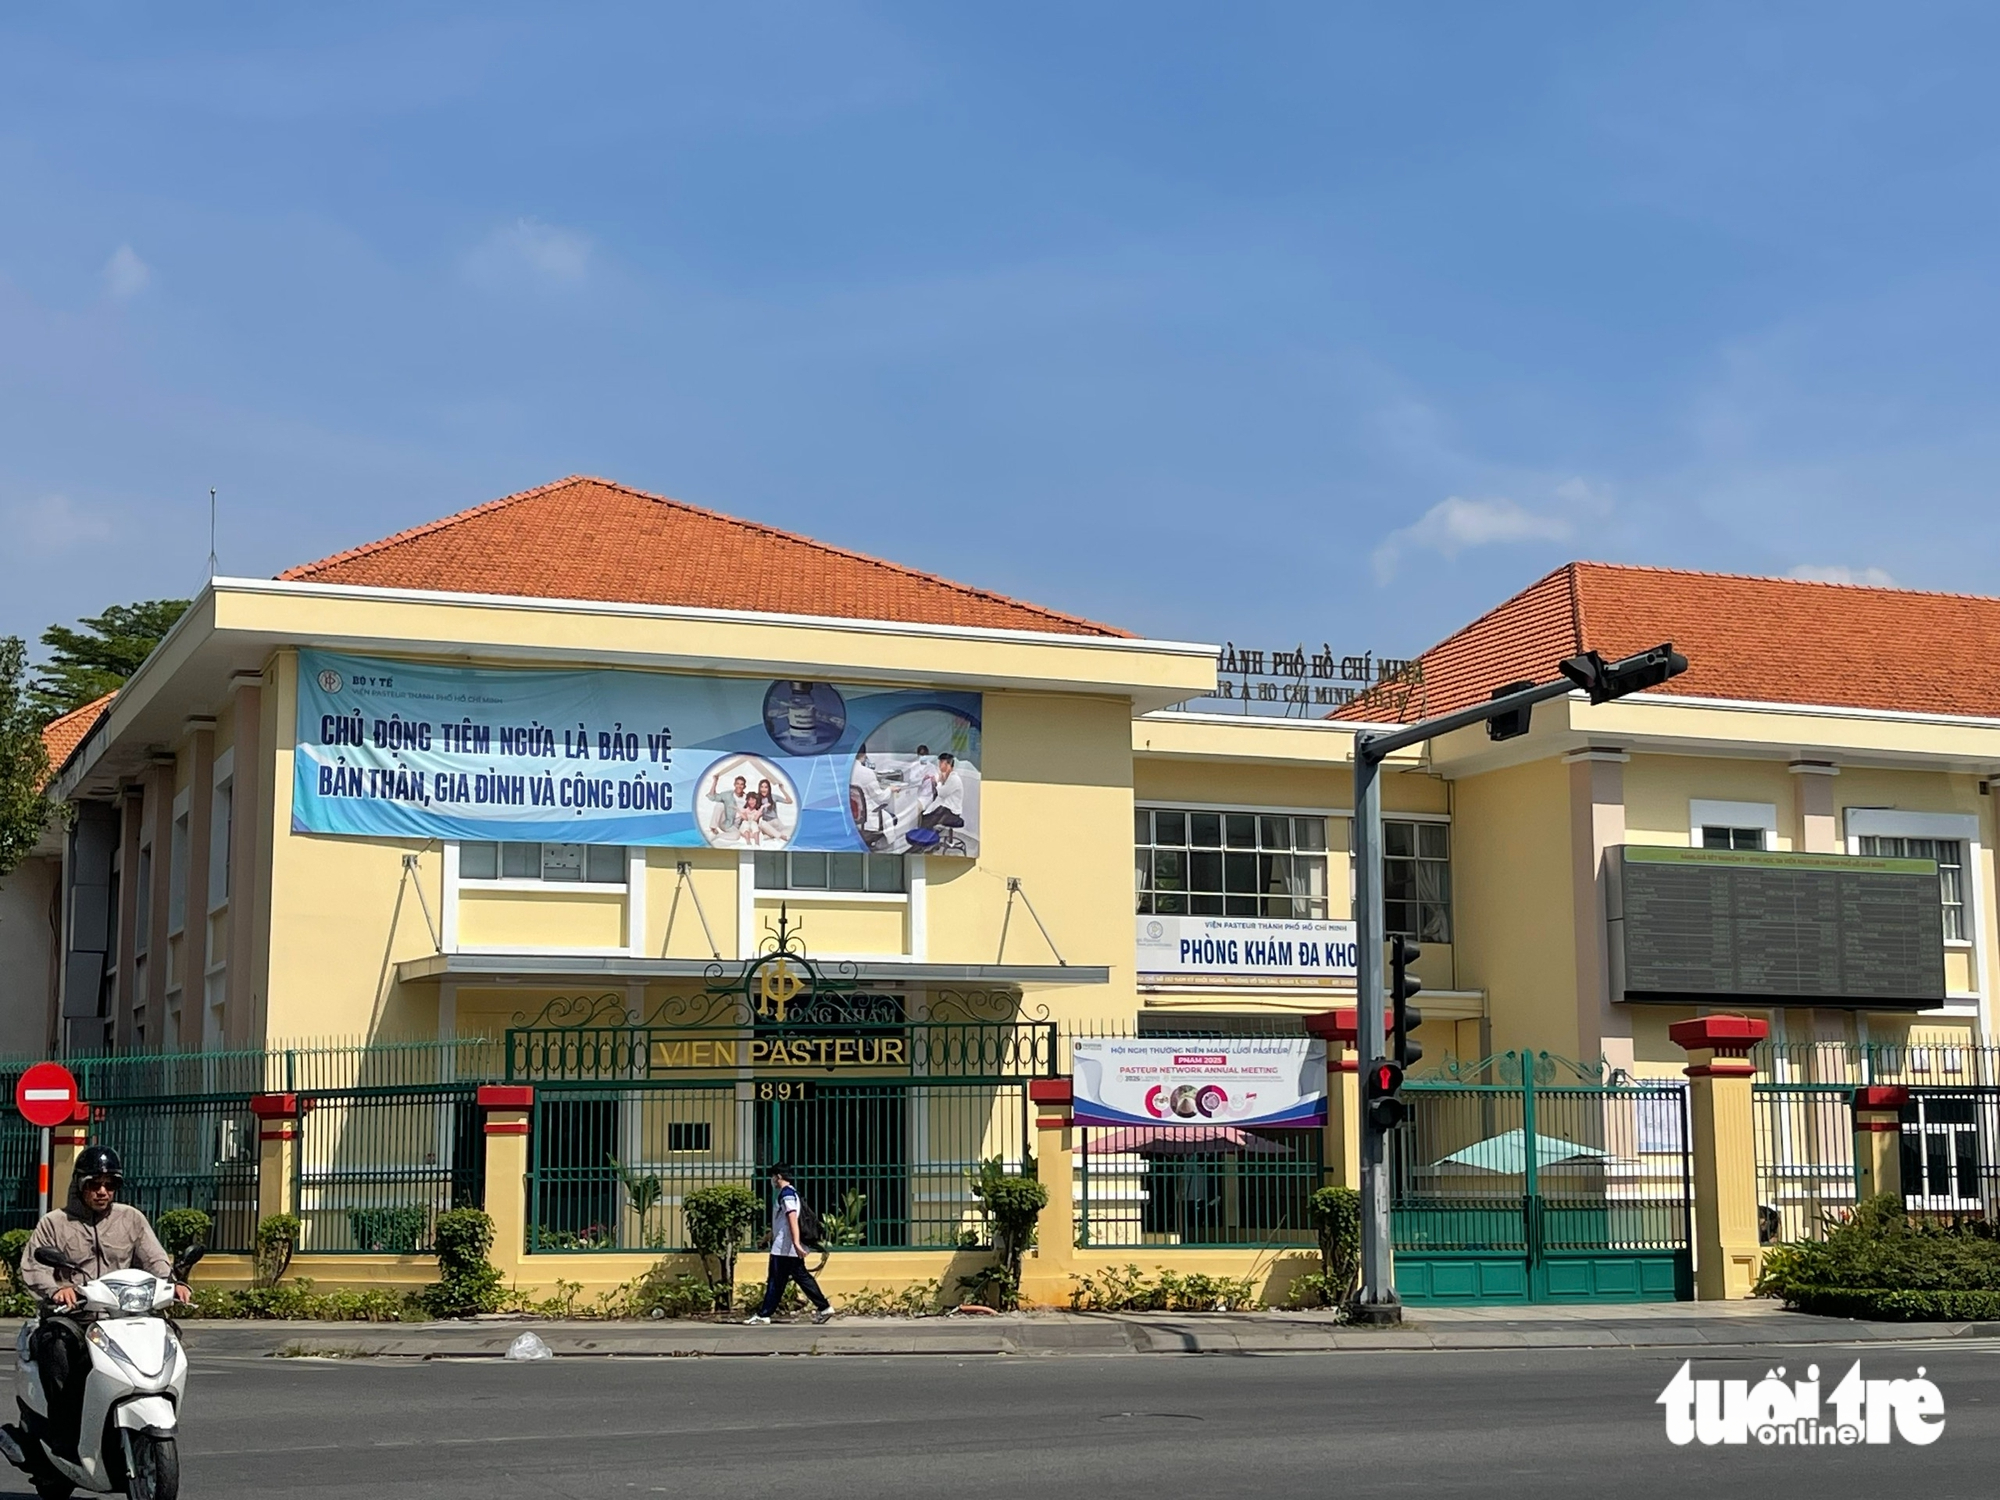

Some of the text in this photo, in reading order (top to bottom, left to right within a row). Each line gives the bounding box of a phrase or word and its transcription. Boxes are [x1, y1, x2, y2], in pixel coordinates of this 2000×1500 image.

[1311, 642, 1334, 679] HỒ
[1341, 650, 1372, 680] CHÍ
[1377, 658, 1423, 684] MINH
[369, 676, 376, 686] Y
[320, 708, 672, 771] CHỦ ĐỘNG TIÊM NGỪA LÀ BẢO VỆ
[319, 756, 673, 816] BẢN THÂN, GIA ĐÌNH VÀ CỘNG ĐỒNG
[1224, 921, 1256, 930] PASTEUR
[1180, 933, 1358, 967] PHÒNG KHÁM ĐA KHO
[748, 1037, 905, 1066] PASTEUR
[1178, 1056, 1202, 1064] PNAM
[1119, 1066, 1279, 1074] PASTEUR NETWORK ANNUAL MEETING
[760, 1082, 805, 1100] 891
